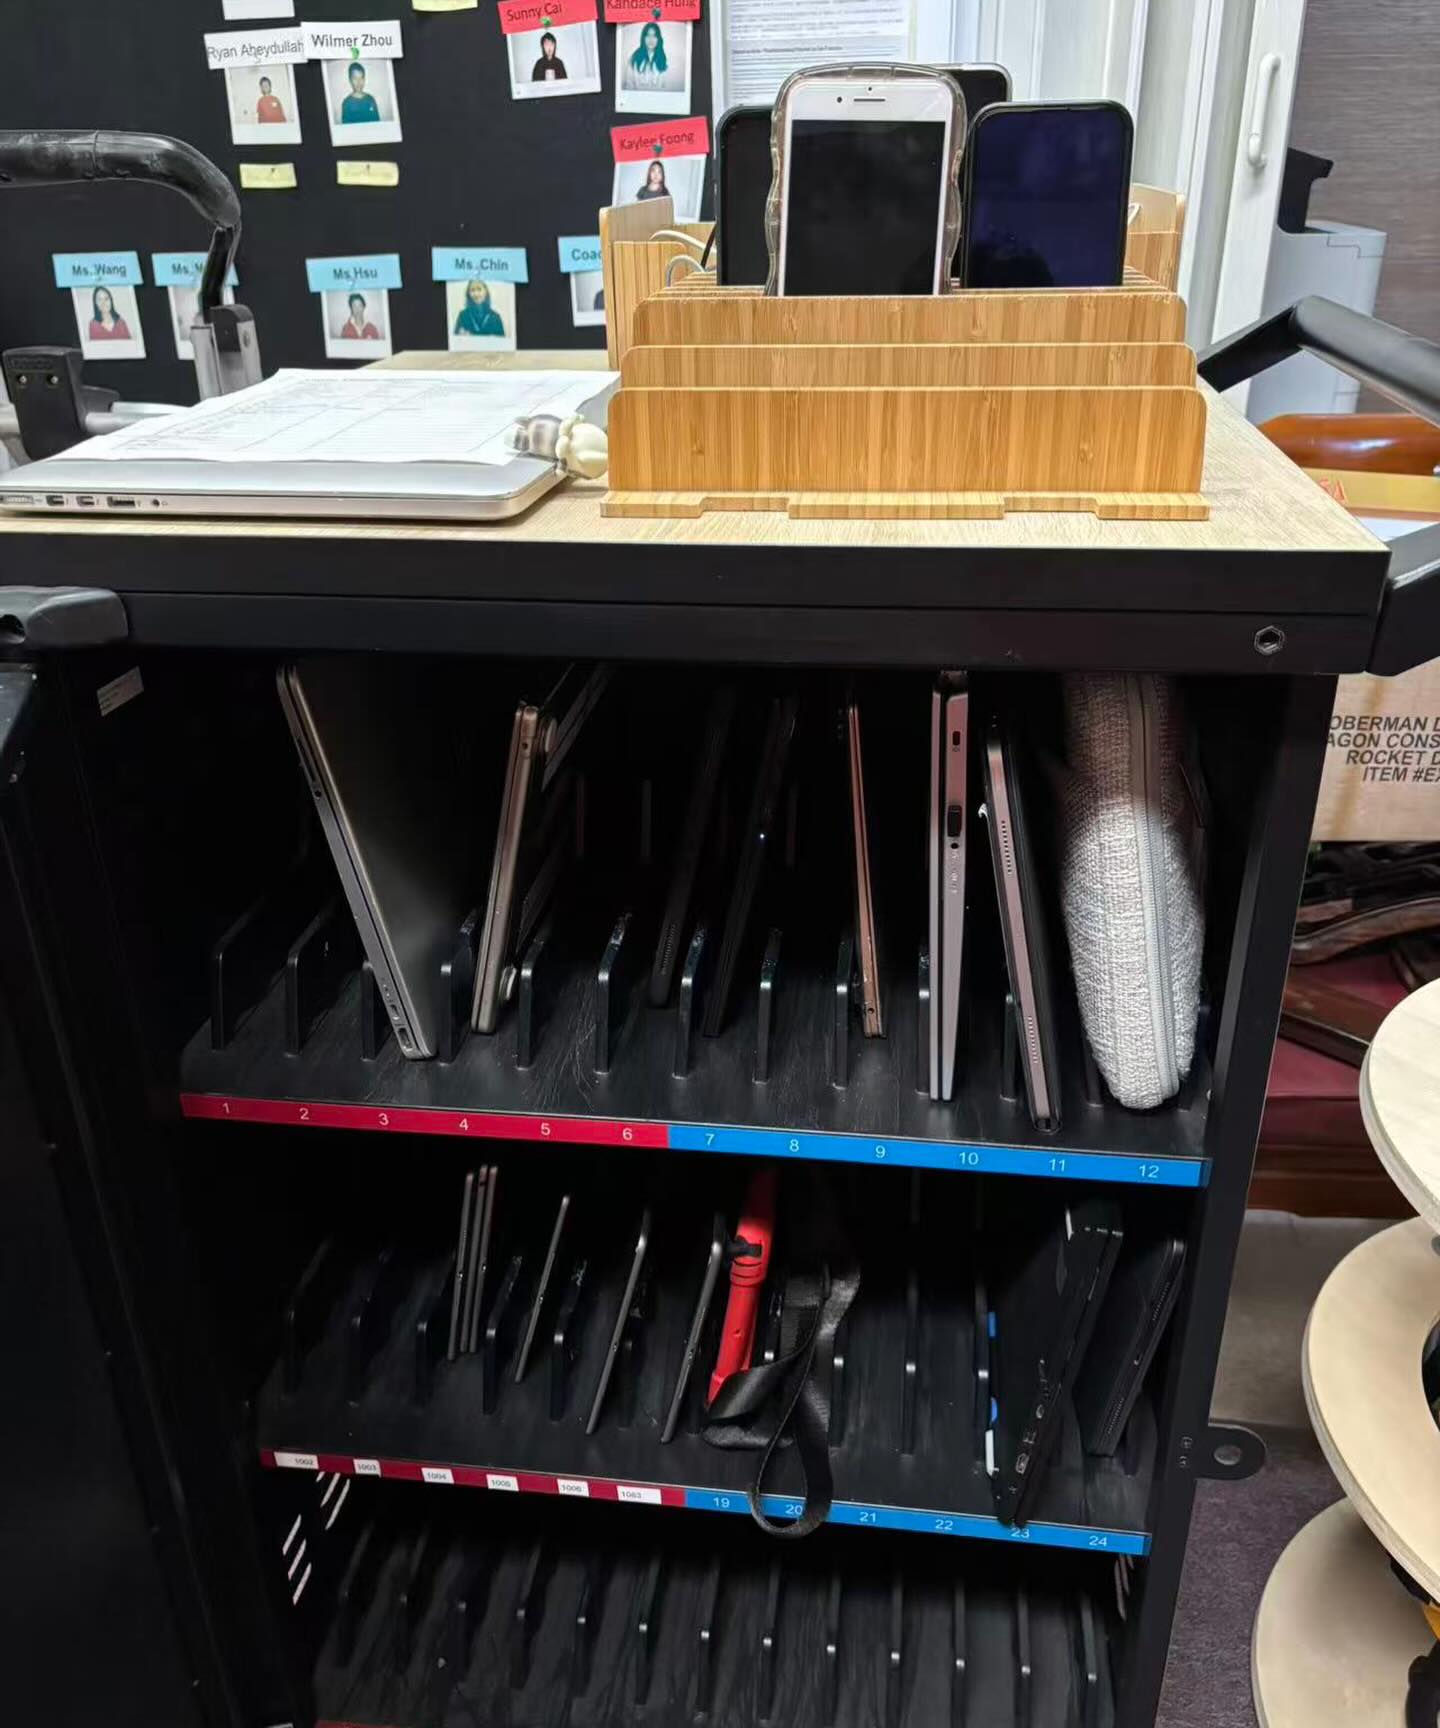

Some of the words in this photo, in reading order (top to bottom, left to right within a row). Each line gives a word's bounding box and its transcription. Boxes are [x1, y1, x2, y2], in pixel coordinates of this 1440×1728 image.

[507, 7, 542, 22] Sunny
[544, 2, 562, 15] Cai
[311, 34, 358, 48] Wilmer
[361, 34, 393, 47] Zhou
[207, 46, 237, 61] Ryan
[94, 263, 127, 278] Wang
[480, 257, 509, 271] Chin
[353, 266, 378, 279] Hsu
[1330, 715, 1428, 732] OBERMAN
[1327, 732, 1381, 748] AGON
[1386, 733, 1440, 748] CONS
[1346, 750, 1427, 766] ROCKET
[1363, 766, 1409, 782] ITEM
[222, 1102, 230, 1114] 1
[299, 1107, 310, 1120] 2
[378, 1113, 389, 1126] 3
[459, 1118, 469, 1131] 4
[540, 1122, 551, 1136] 5
[622, 1127, 633, 1141] 6
[705, 1133, 715, 1146] 7
[789, 1139, 800, 1152] 8
[875, 1145, 886, 1159] 9
[958, 1151, 980, 1166] 10
[1049, 1158, 1066, 1172] 11
[1138, 1164, 1160, 1179] 12
[712, 1497, 730, 1508] 19
[785, 1504, 803, 1516] 20
[859, 1511, 877, 1523] 21
[935, 1519, 953, 1531] 22
[1010, 1526, 1030, 1538] 23
[1088, 1535, 1108, 1547] 24
